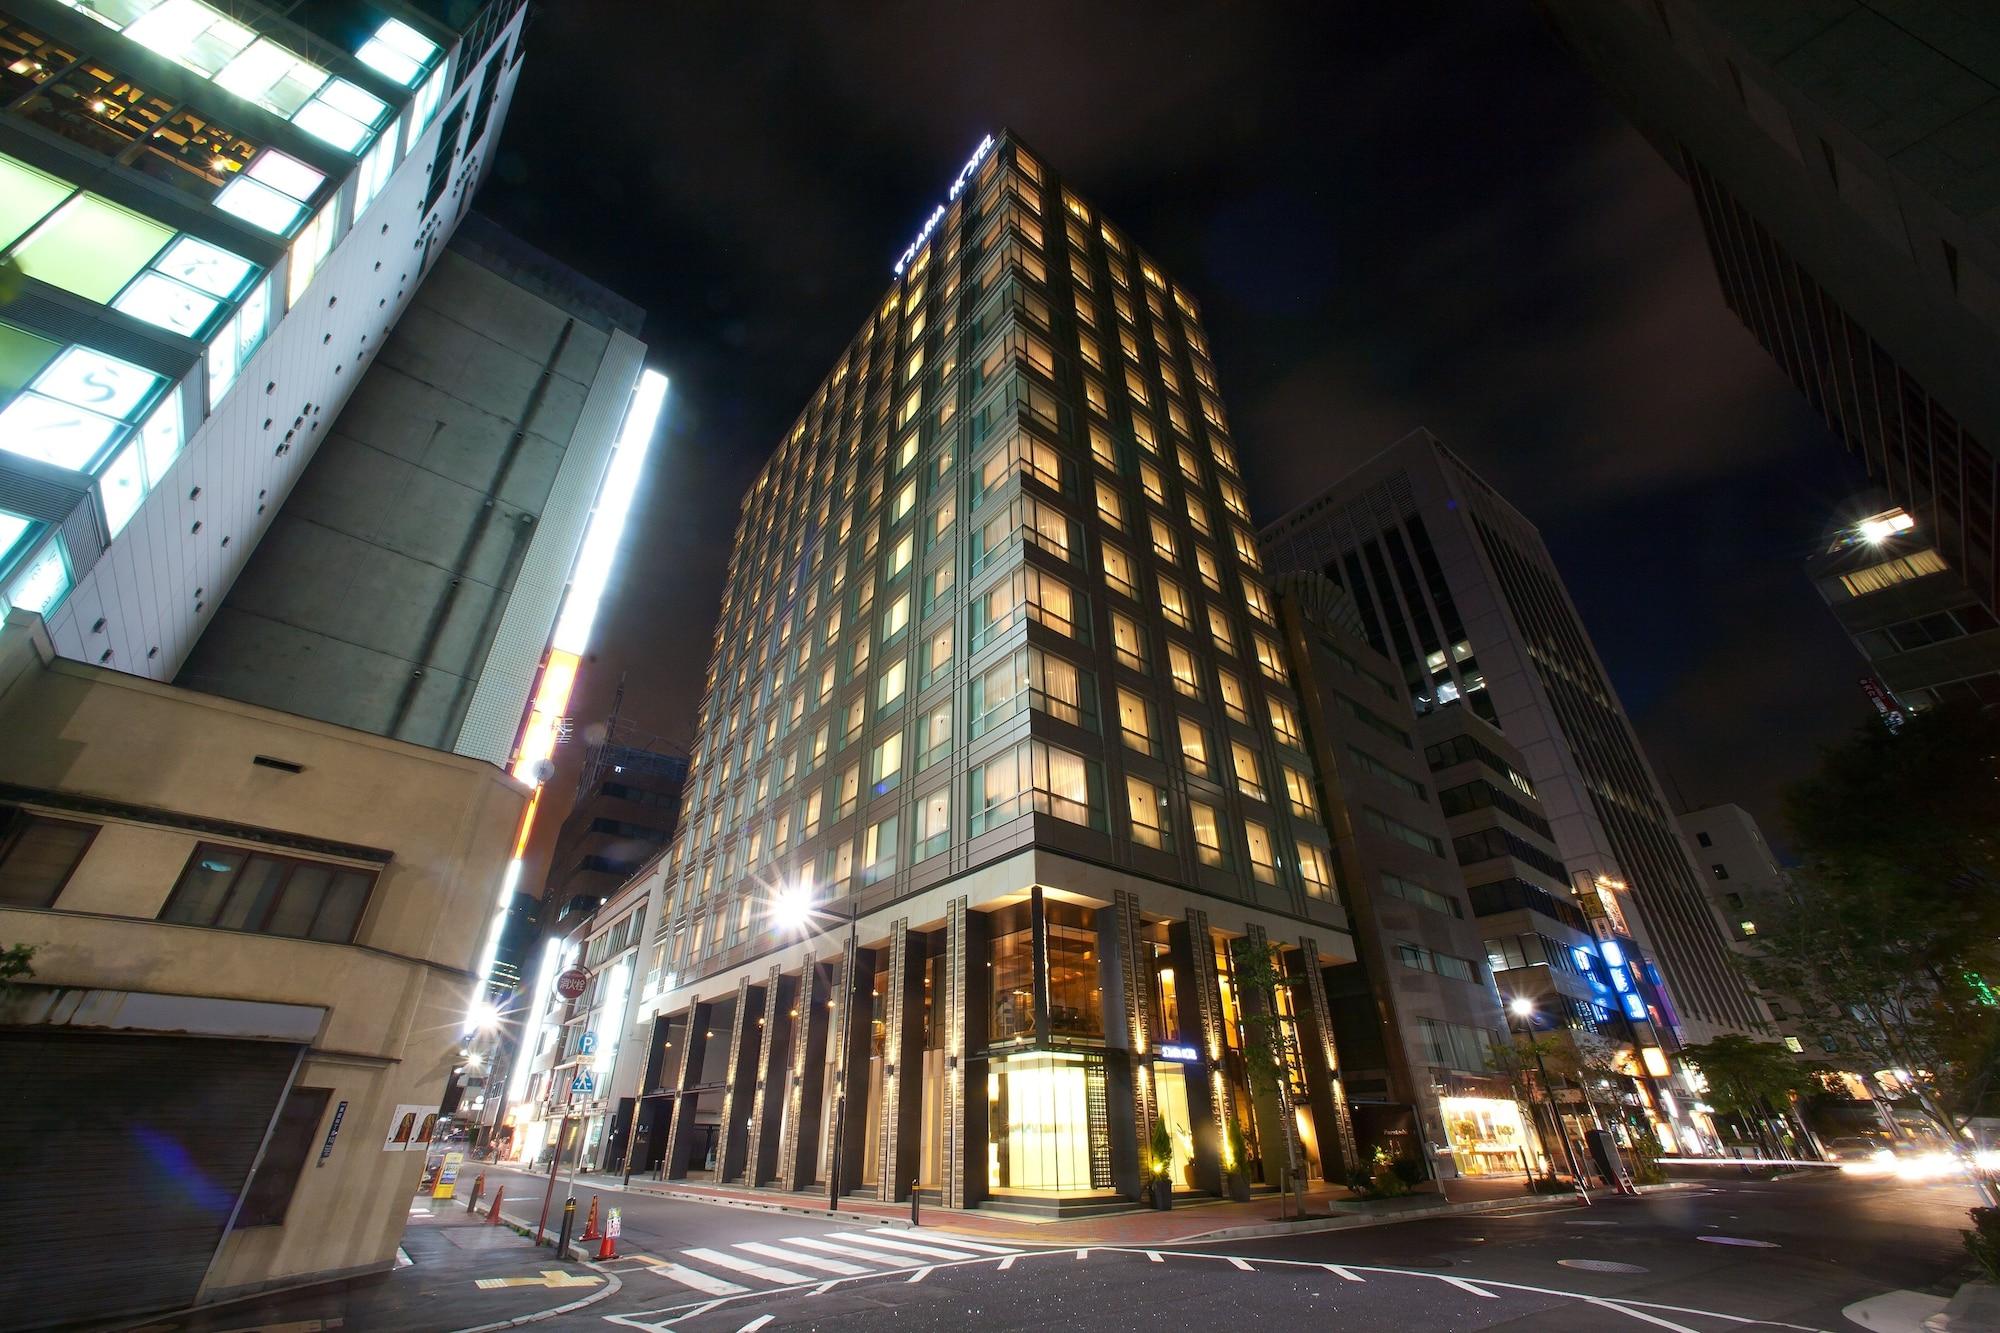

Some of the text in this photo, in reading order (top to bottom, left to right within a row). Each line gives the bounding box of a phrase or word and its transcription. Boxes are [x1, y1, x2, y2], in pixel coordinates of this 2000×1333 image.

[949, 133, 996, 201] HOTEL
[559, 977, 586, 992] 消火栓
[582, 1036, 593, 1052] P
